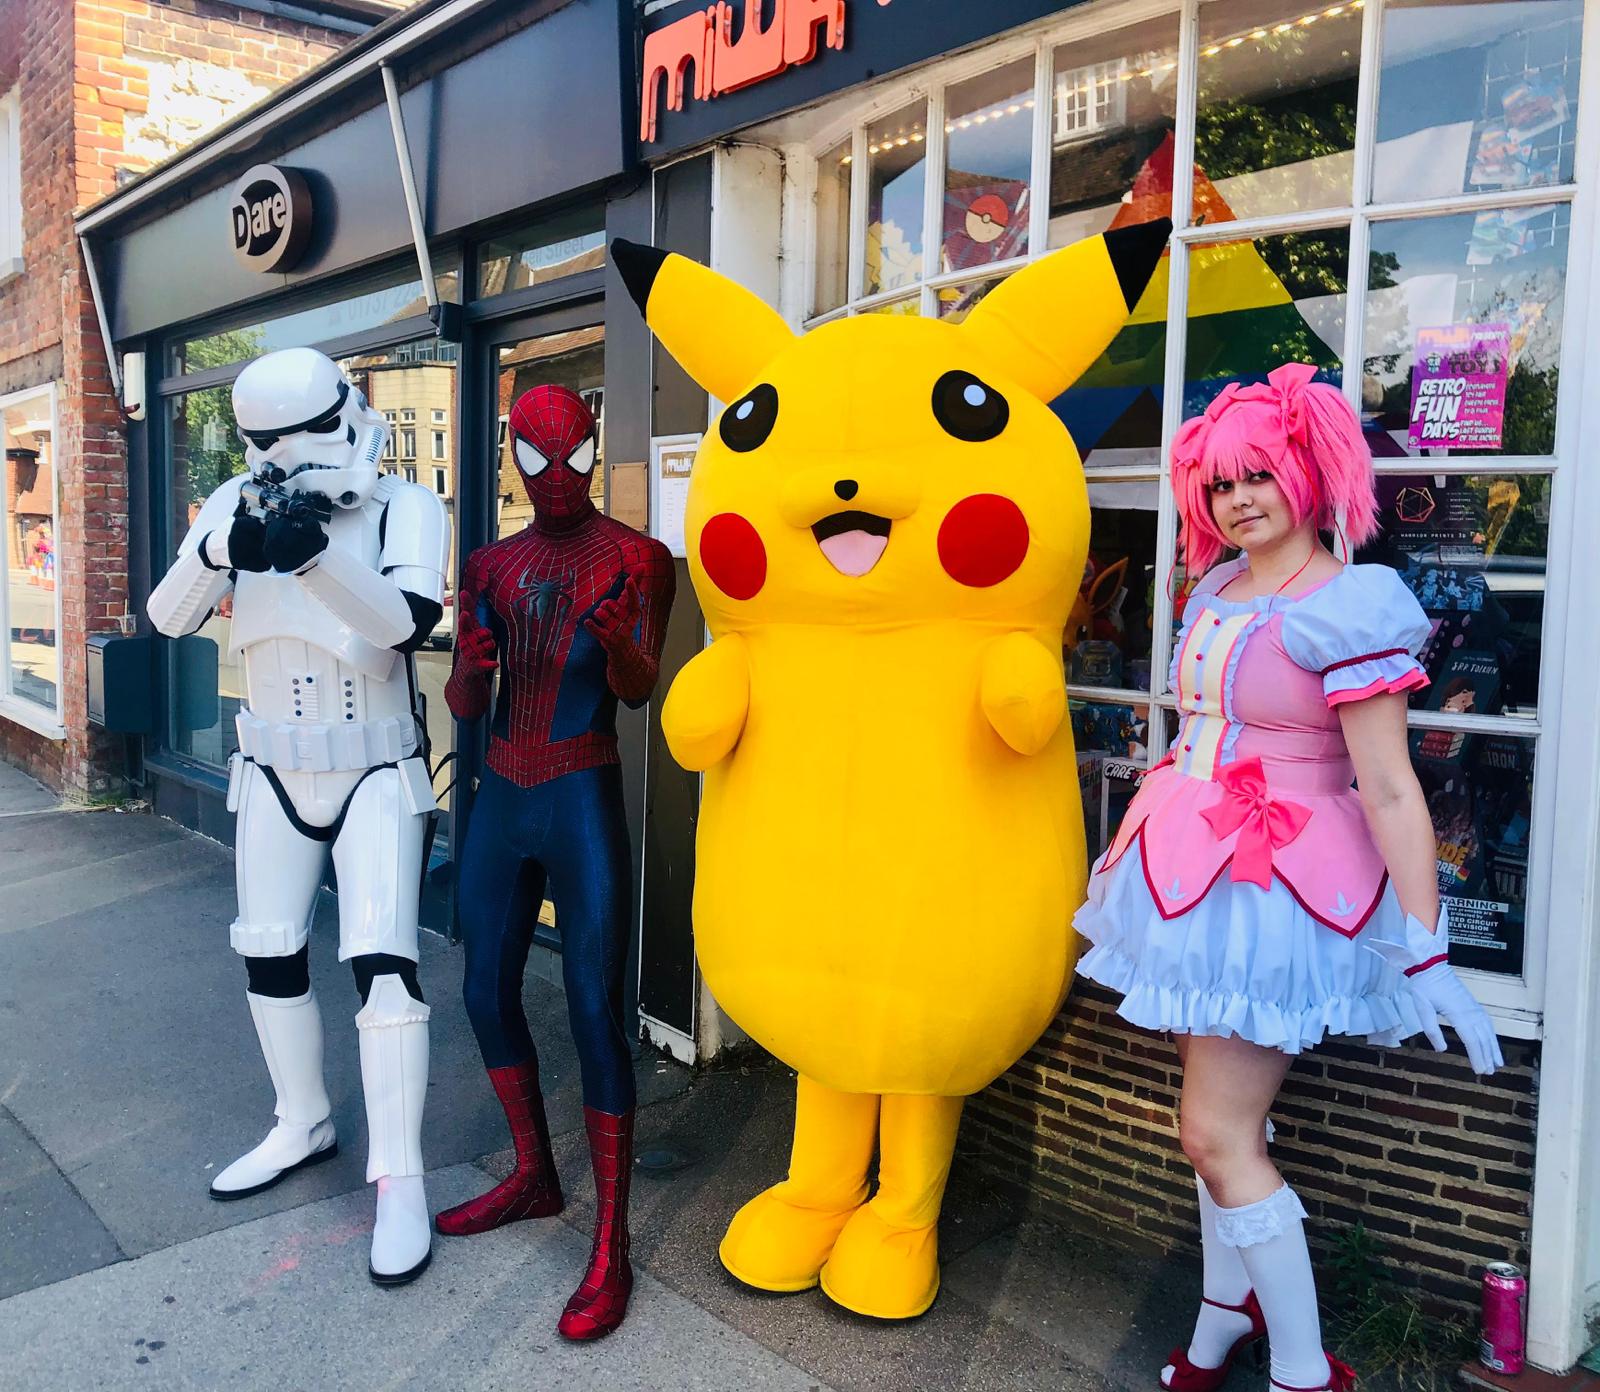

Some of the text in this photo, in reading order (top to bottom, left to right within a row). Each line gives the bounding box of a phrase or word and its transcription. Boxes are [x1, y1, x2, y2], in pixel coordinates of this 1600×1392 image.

[232, 192, 287, 249] Dare
[544, 237, 585, 260] Street
[1419, 377, 1467, 397] RETRO
[1412, 396, 1462, 423] FUN
[1421, 422, 1460, 440] DAYS
[1470, 663, 1499, 675] TOLKIEN
[1104, 763, 1136, 780] CARE
[1435, 838, 1469, 866] IDE
[1435, 859, 1461, 876] RREY
[1440, 897, 1499, 911] WARNING
[1448, 921, 1490, 932] ELEVISION
[1466, 918, 1499, 928] CIRCUIT
[1472, 939, 1503, 949] recording
